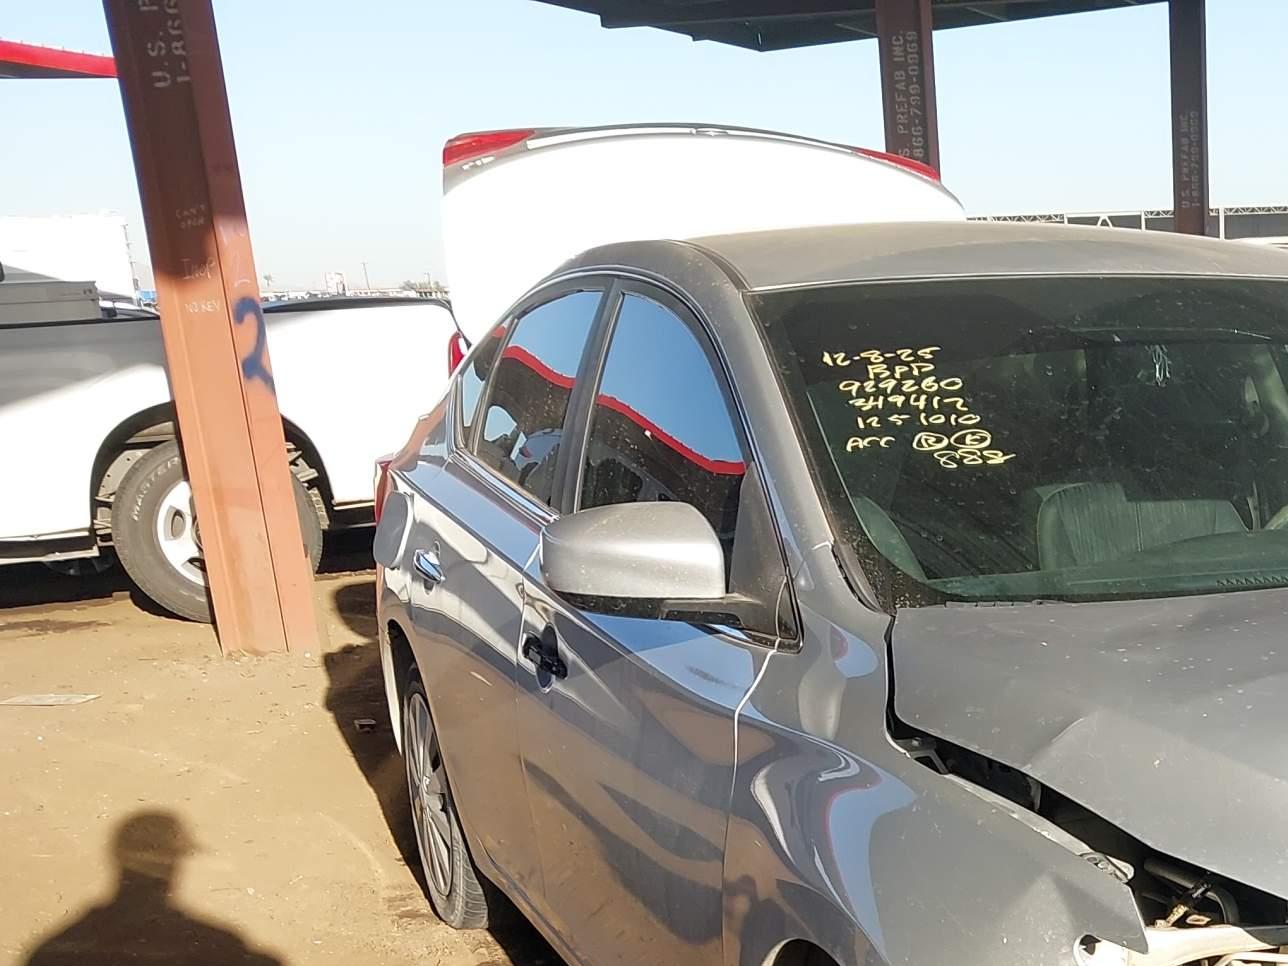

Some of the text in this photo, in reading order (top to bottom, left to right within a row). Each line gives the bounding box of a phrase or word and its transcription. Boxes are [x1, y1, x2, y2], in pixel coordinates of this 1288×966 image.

[894, 70, 910, 135] PREFAB
[822, 346, 941, 367] 12-8-25
[838, 376, 963, 397] 929260
[848, 393, 969, 412] 349412
[846, 436, 896, 452] ACC
